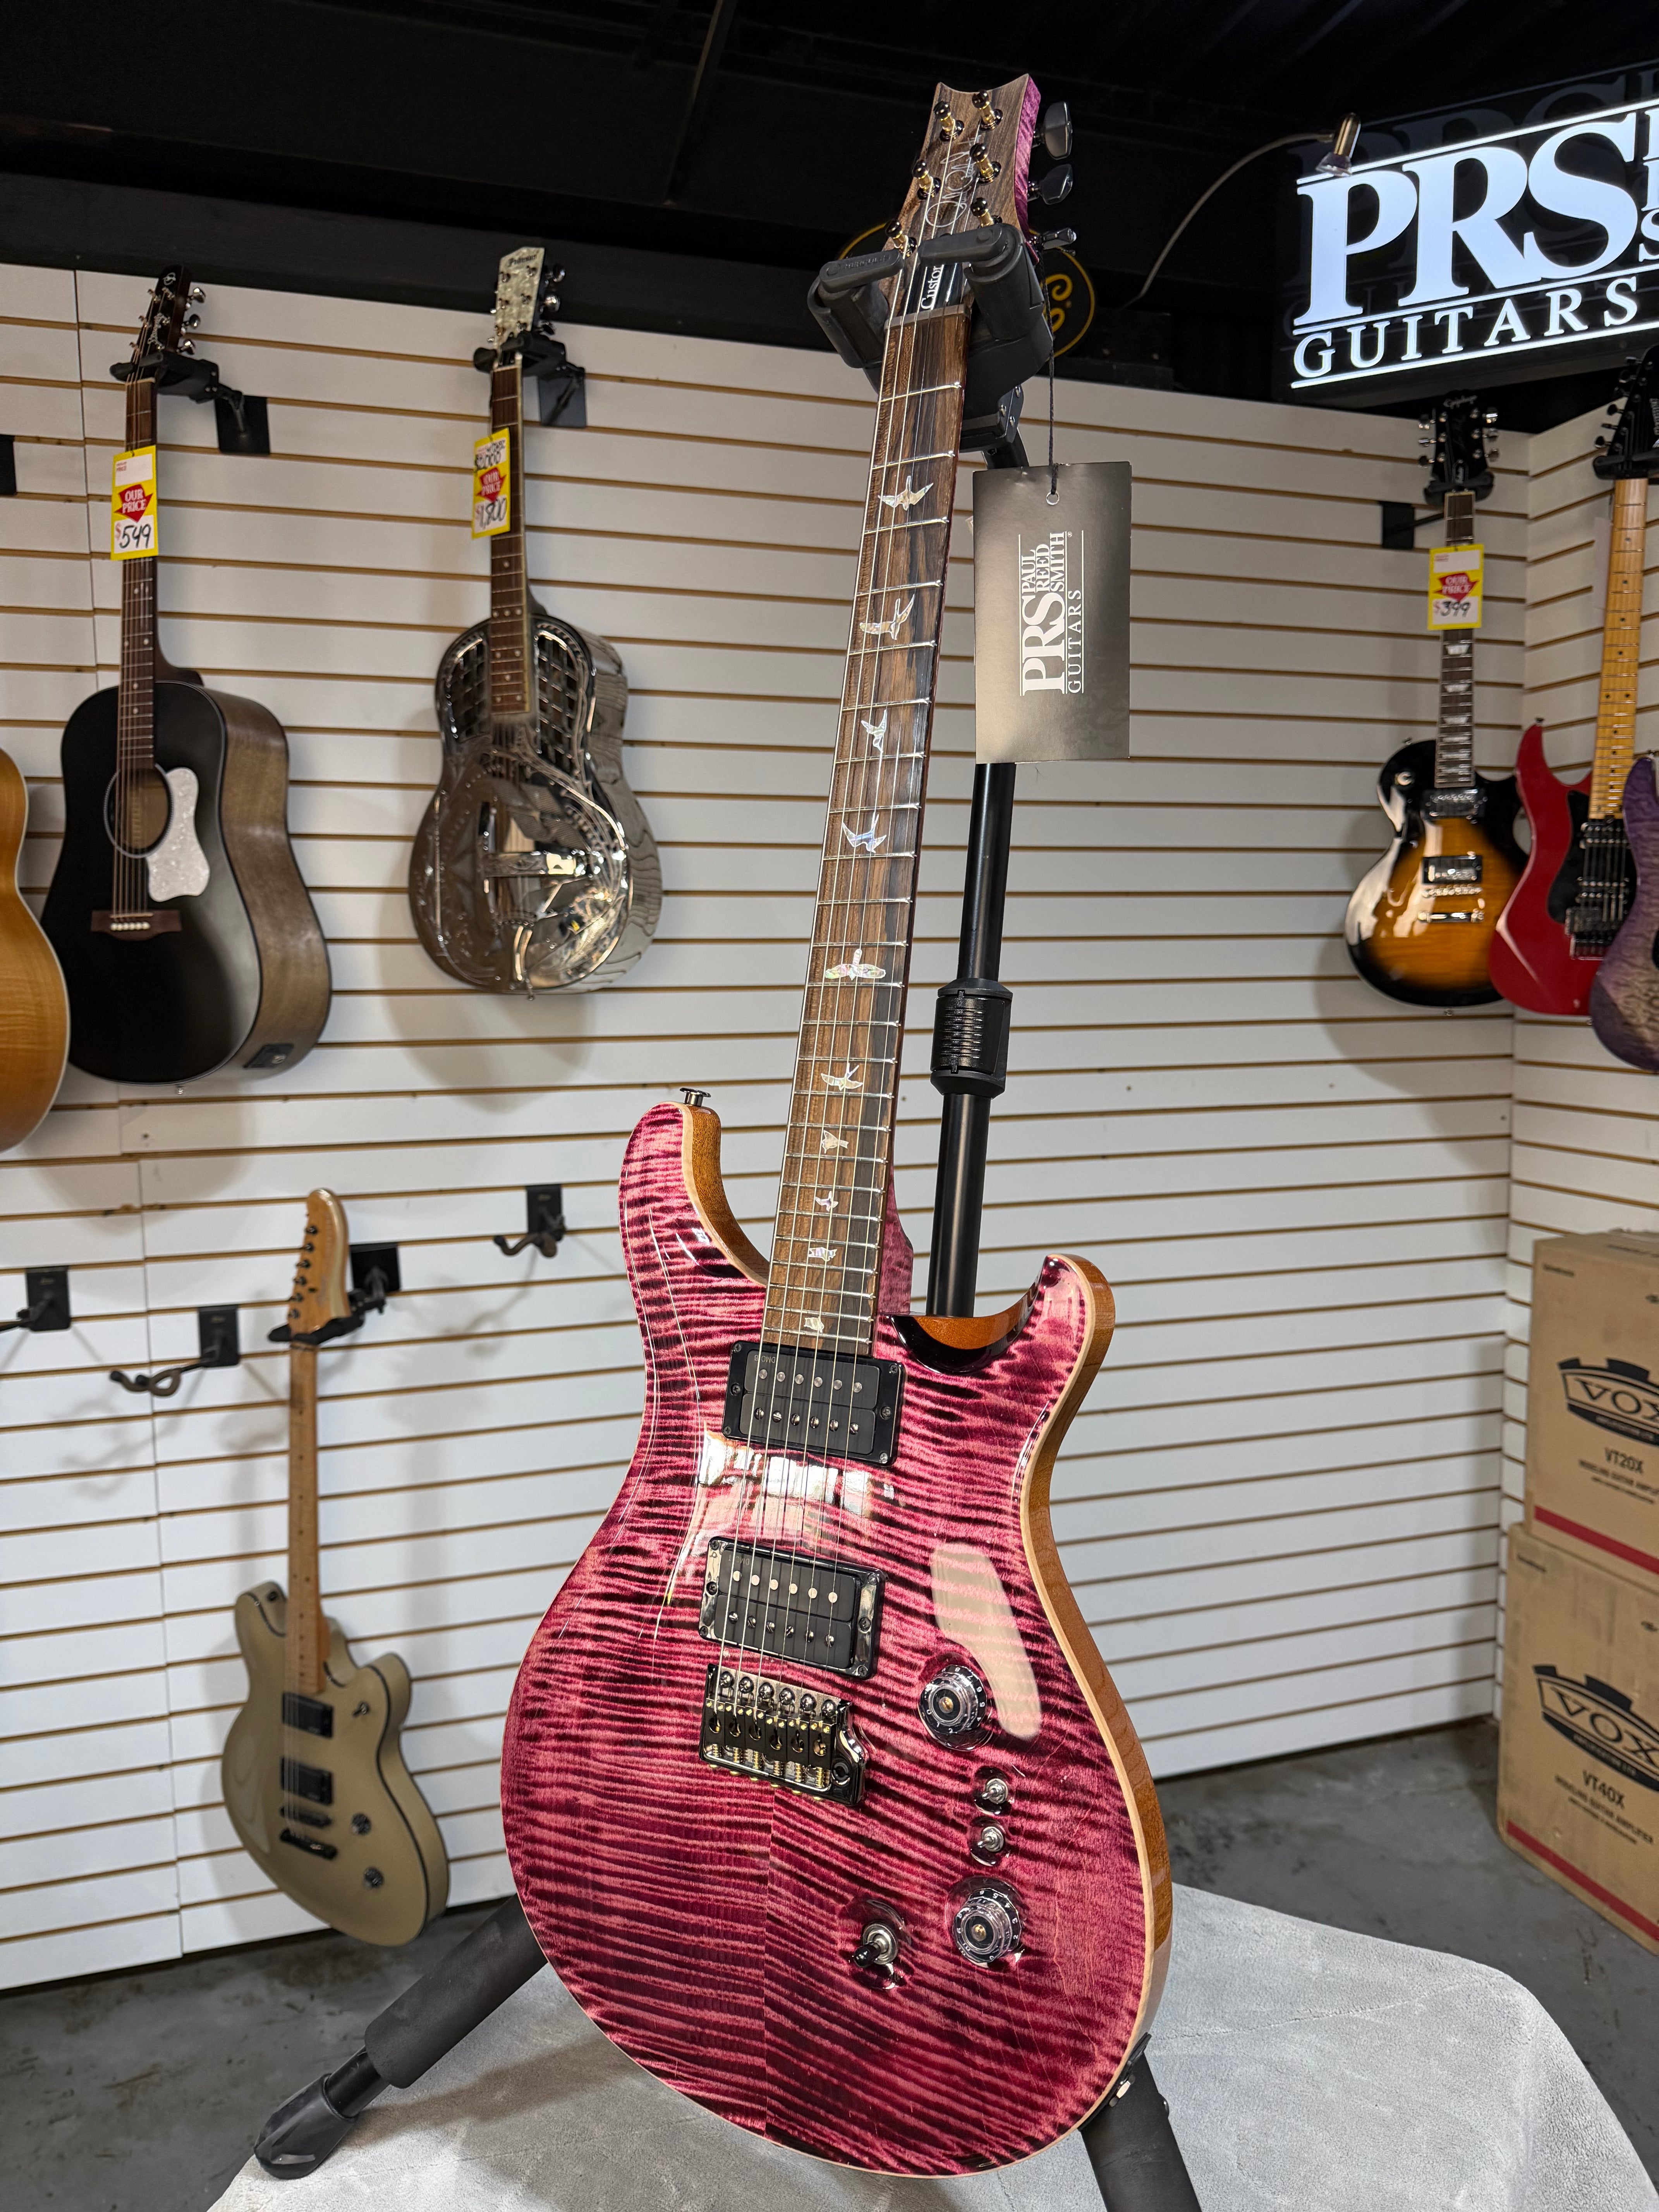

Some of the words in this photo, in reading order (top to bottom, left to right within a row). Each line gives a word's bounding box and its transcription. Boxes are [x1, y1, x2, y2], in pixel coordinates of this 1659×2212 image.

[1294, 112, 1637, 326] PRS
[1294, 276, 1637, 378] GUITARS
[122, 498, 147, 514] PRICE
[125, 489, 143, 501] OUR
[1021, 550, 1036, 594] PAUL
[1036, 544, 1050, 593] REED
[1050, 532, 1065, 592] SMITH
[1445, 575, 1468, 586] OUR
[1442, 584, 1471, 594] PRICE
[1022, 592, 1065, 696] PRS
[1068, 590, 1081, 693] GUITARS
[1605, 1447, 1643, 1474] VT20X
[1583, 1769, 1625, 1809] VT40X
